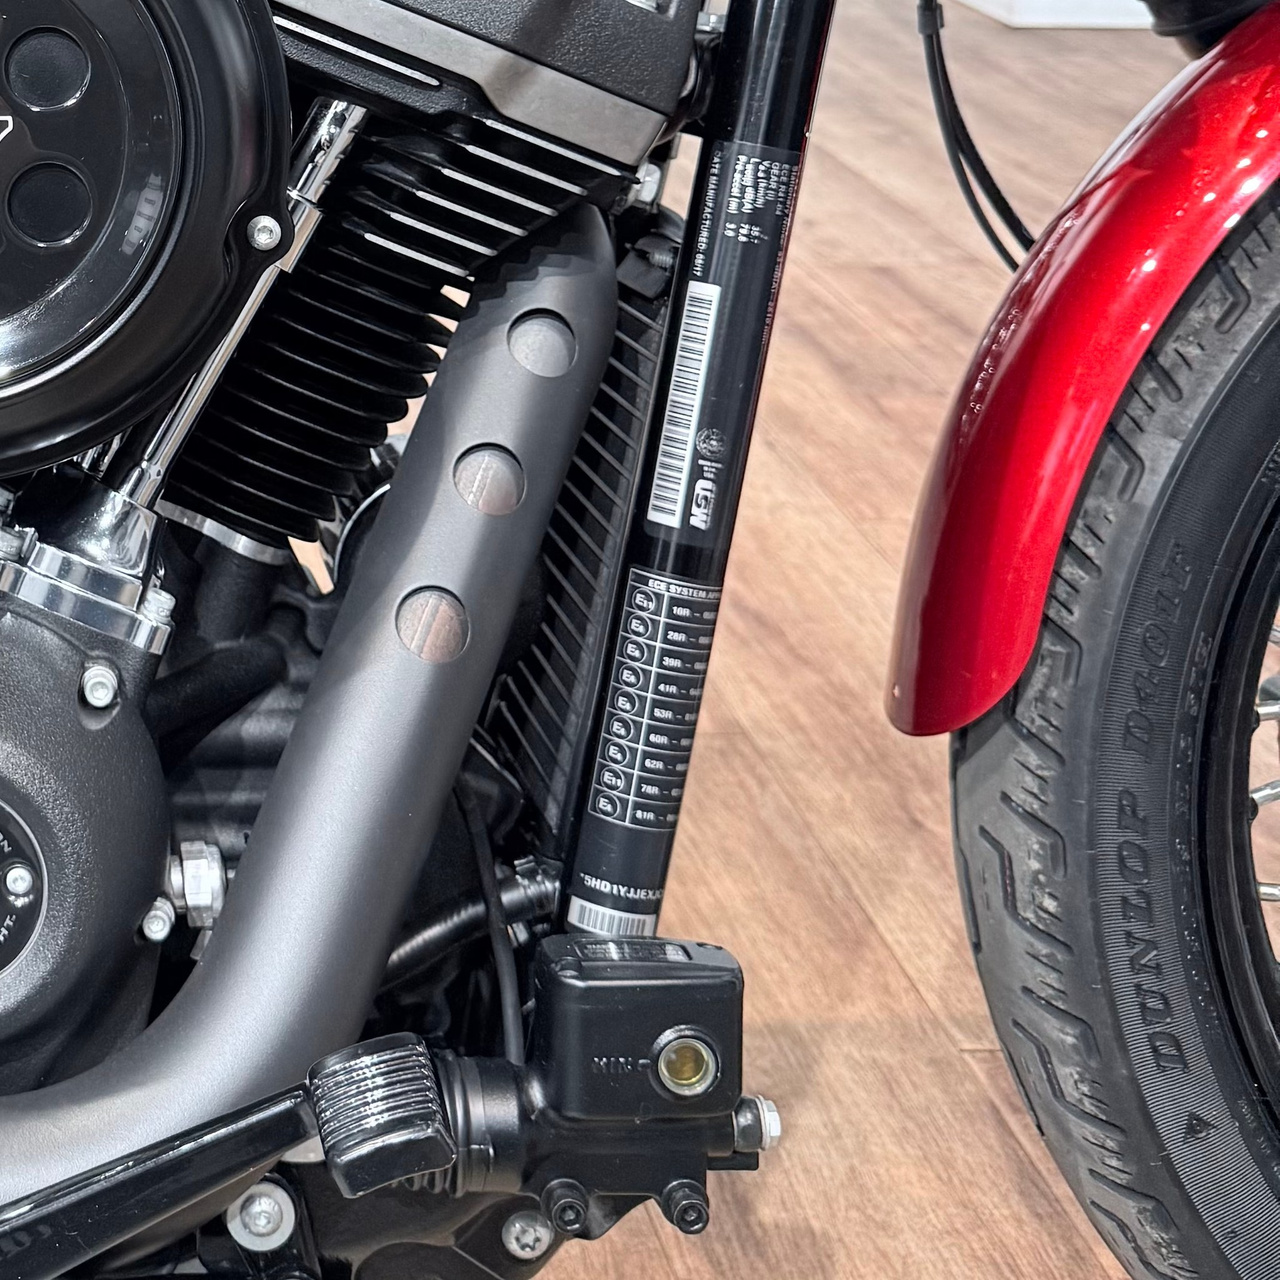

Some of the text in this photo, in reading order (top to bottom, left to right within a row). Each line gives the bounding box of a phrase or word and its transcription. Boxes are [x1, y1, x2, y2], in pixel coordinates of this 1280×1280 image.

[768, 162, 780, 189] GEAR
[648, 579, 668, 591] ECE
[668, 584, 707, 599] SYSTEM
[1118, 786, 1187, 1071] DUNLOP
